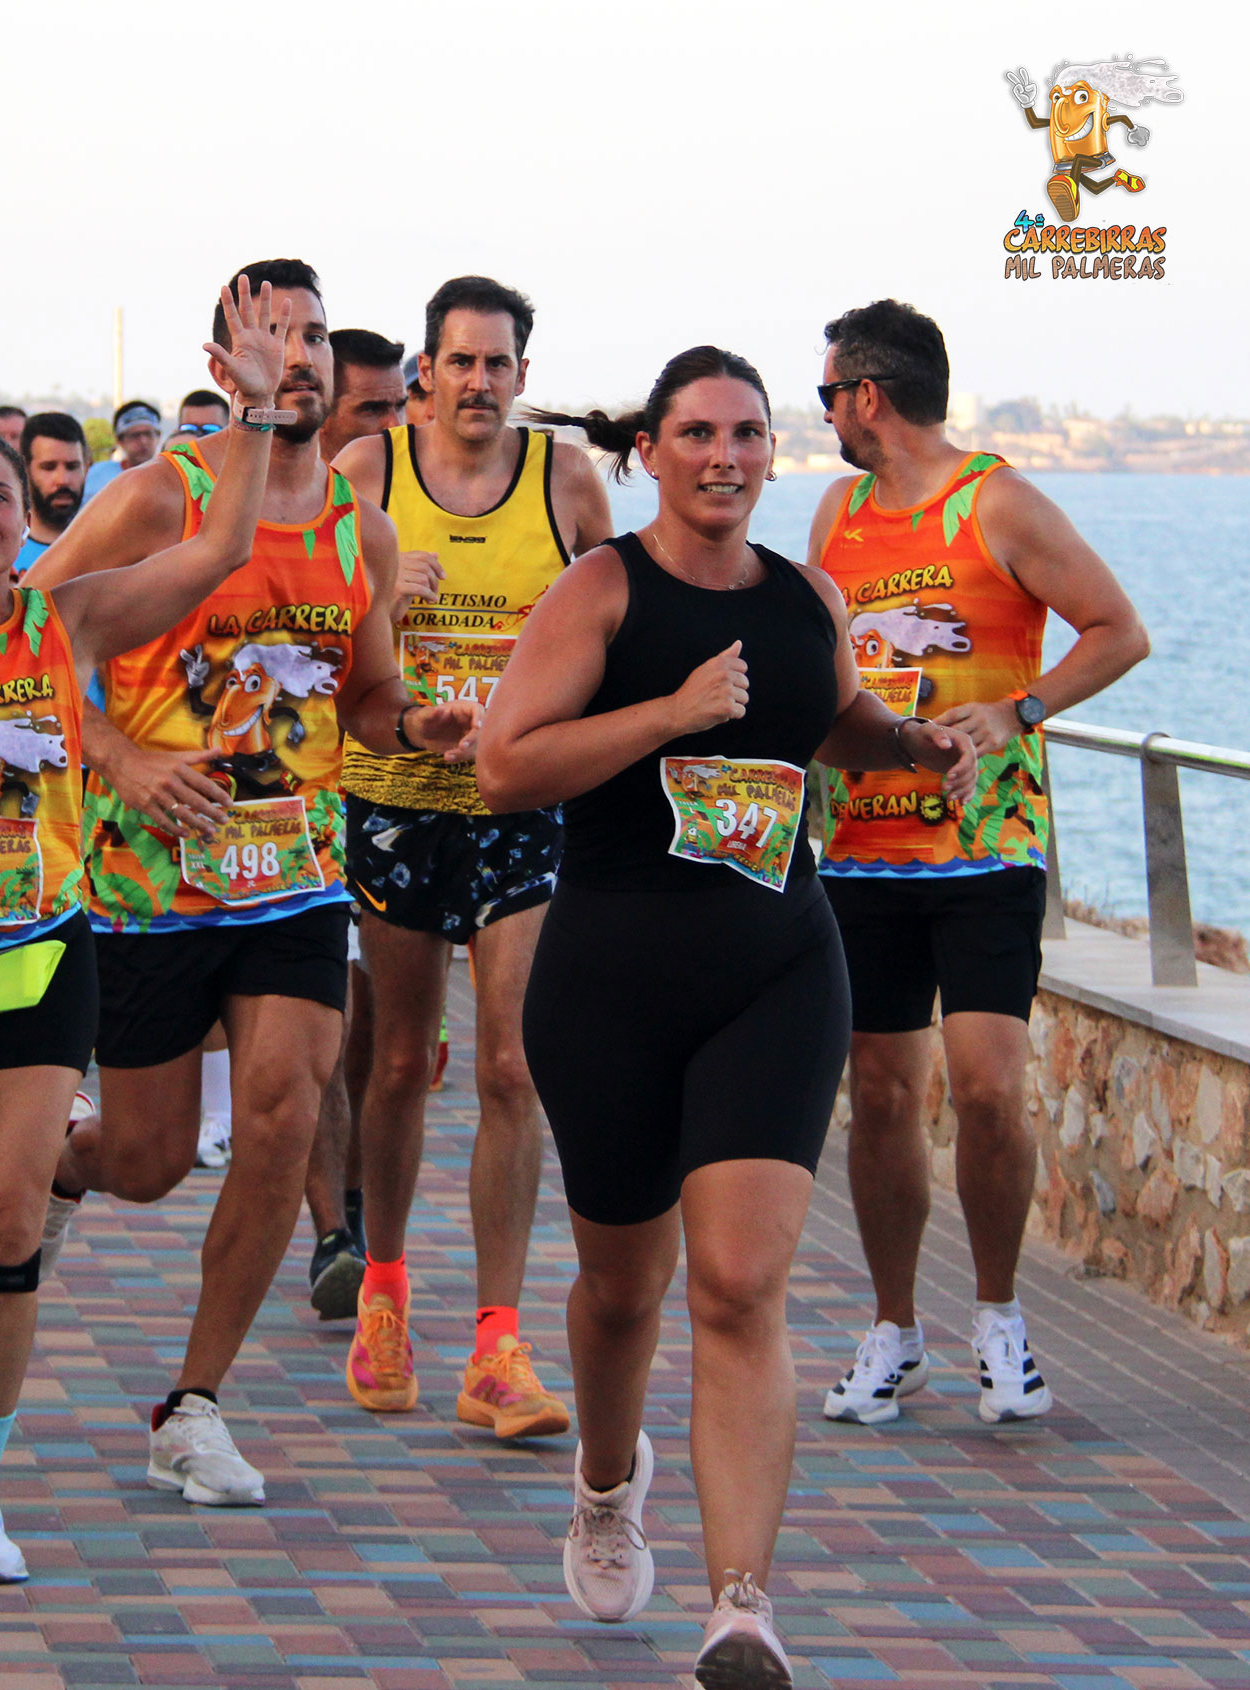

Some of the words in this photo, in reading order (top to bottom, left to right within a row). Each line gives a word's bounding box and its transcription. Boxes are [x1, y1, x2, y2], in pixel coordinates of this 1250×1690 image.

[856, 565, 954, 604] CARRERA
[209, 614, 241, 637] LA
[246, 603, 351, 637] CARRERA
[413, 612, 495, 629] ORADADA
[436, 674, 501, 711] 547
[716, 798, 778, 849] 347
[220, 842, 280, 880] 498
